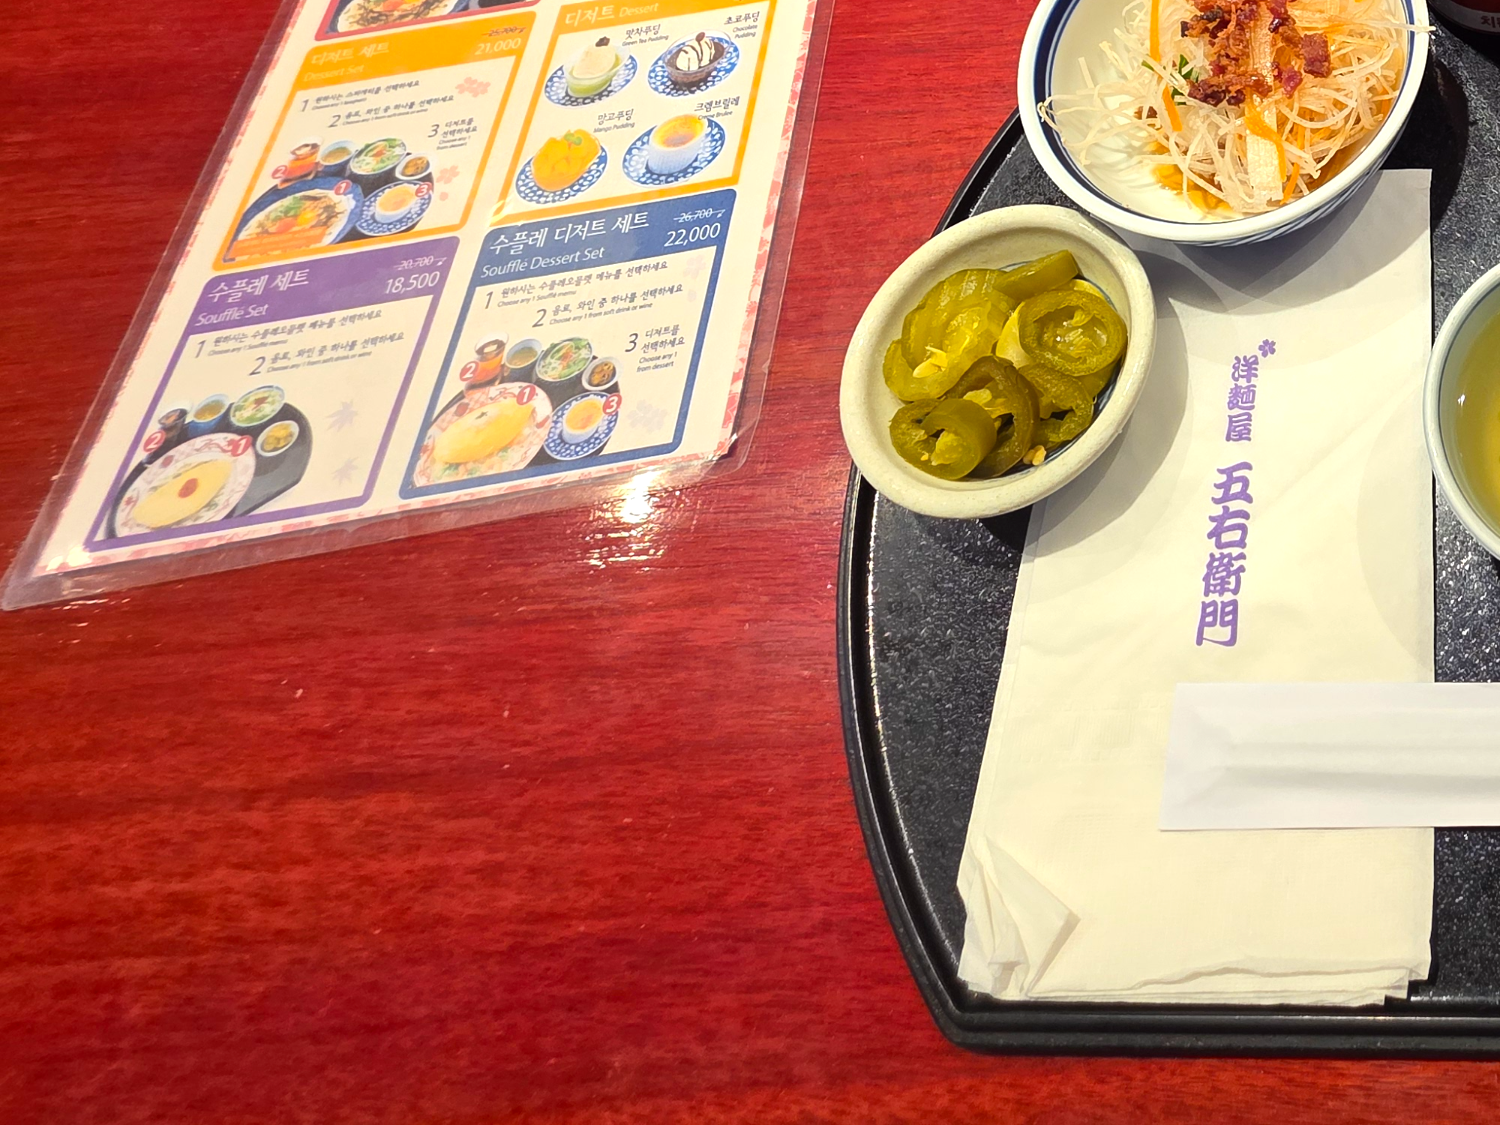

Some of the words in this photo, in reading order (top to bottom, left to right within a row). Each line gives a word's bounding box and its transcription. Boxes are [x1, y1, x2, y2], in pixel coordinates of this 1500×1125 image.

[565, 5, 615, 27] 디저트
[619, 3, 659, 18] Dessert
[724, 11, 760, 26] 초코푸딩
[625, 24, 661, 40] 맛차푸딩
[733, 24, 758, 32] Chocolate
[735, 31, 756, 40] Pudding
[475, 38, 521, 55] 21,000
[621, 38, 638, 47] Green
[647, 34, 670, 44] Pudding
[311, 49, 353, 65] 디저트
[358, 42, 390, 57] 세트
[303, 68, 346, 82] Dessert
[347, 65, 365, 75] Set
[301, 99, 309, 112] 1
[328, 115, 341, 128] 2
[597, 109, 634, 125] 망고푸딩
[427, 124, 439, 137] 3
[593, 124, 612, 134] Mango
[612, 121, 635, 131] Pudding
[490, 228, 548, 255] 수플레
[554, 219, 606, 244] 디저트
[611, 211, 649, 233] 세트
[664, 223, 721, 247] 22,000
[481, 258, 528, 278] Soufflé
[529, 251, 581, 270] Dessert
[583, 246, 605, 261] Set
[208, 275, 269, 303] 수플레
[270, 269, 309, 291] 세트
[386, 271, 440, 294] 18,500
[484, 291, 493, 309] 1
[501, 283, 536, 298] 원하시는
[625, 261, 668, 278] 선택하세요
[245, 304, 269, 318] Set
[531, 309, 547, 328] 2
[577, 298, 594, 311] 와인
[598, 297, 607, 308] 중
[611, 292, 637, 304] 하나를
[640, 284, 683, 301] 선택하세요
[624, 333, 639, 353] 3
[645, 324, 680, 339] 디저트를
[641, 337, 685, 354] 선택하세요
[195, 340, 206, 358] 1
[248, 356, 266, 376] 2
[463, 363, 474, 379] 2
[522, 388, 532, 402] 1
[606, 398, 618, 413] 3
[147, 433, 161, 449] 2
[237, 438, 247, 453] 1
[1195, 461, 1254, 647] 五右衛門
